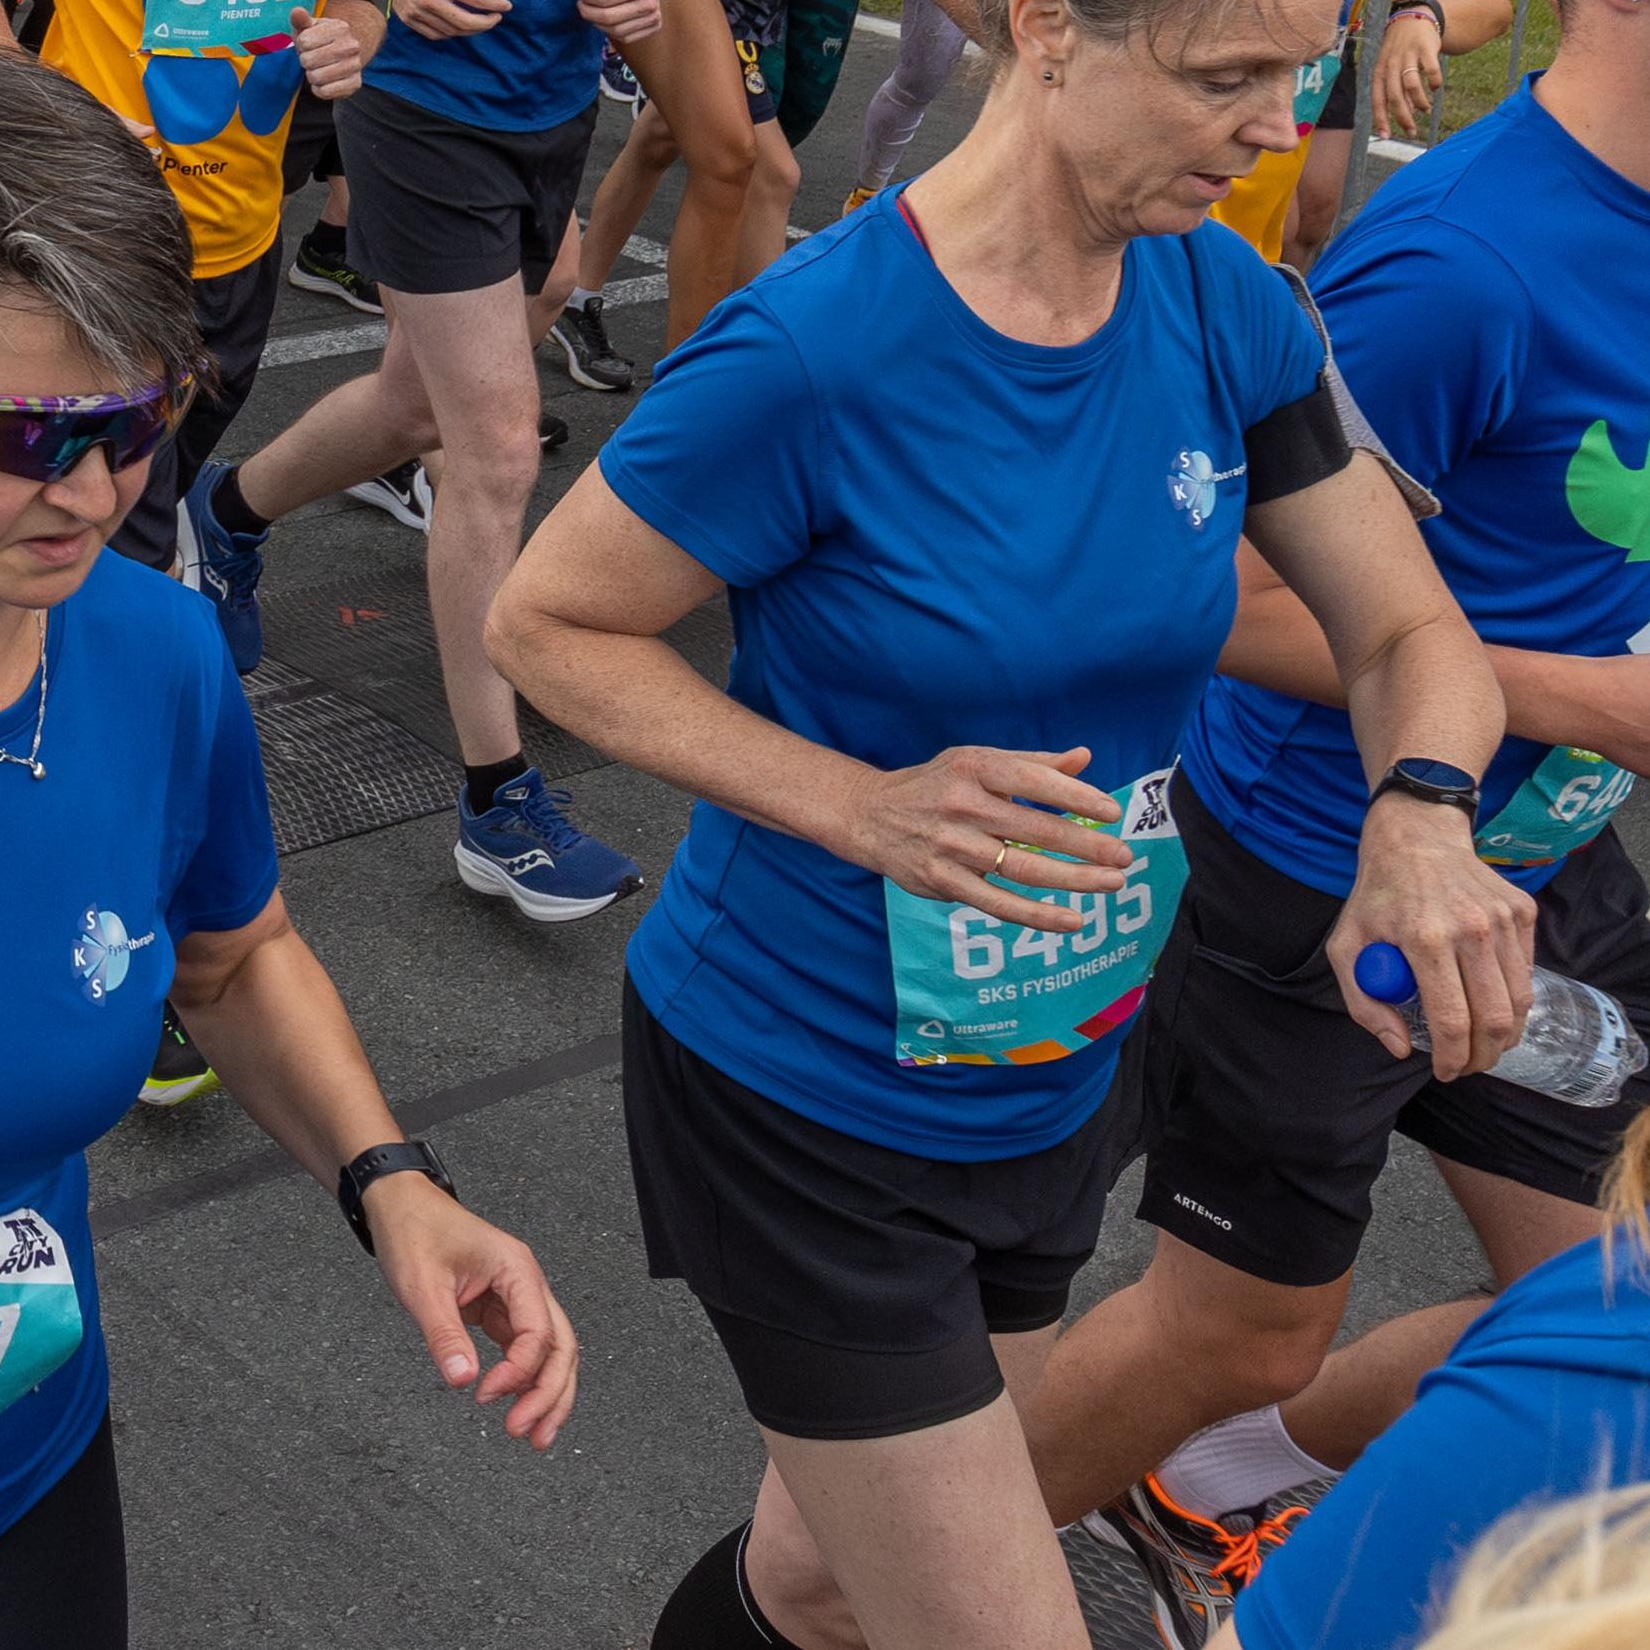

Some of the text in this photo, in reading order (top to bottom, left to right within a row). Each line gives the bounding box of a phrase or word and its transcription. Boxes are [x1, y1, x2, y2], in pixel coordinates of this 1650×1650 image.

[220, 8, 261, 20] PIENTER
[1131, 812, 1170, 835] RUN
[976, 940, 1140, 1006] SKS FYSIOTHERAPIE
[952, 1018, 1019, 1036] Ultraware
[1173, 1192, 1233, 1232] ARTENGO
